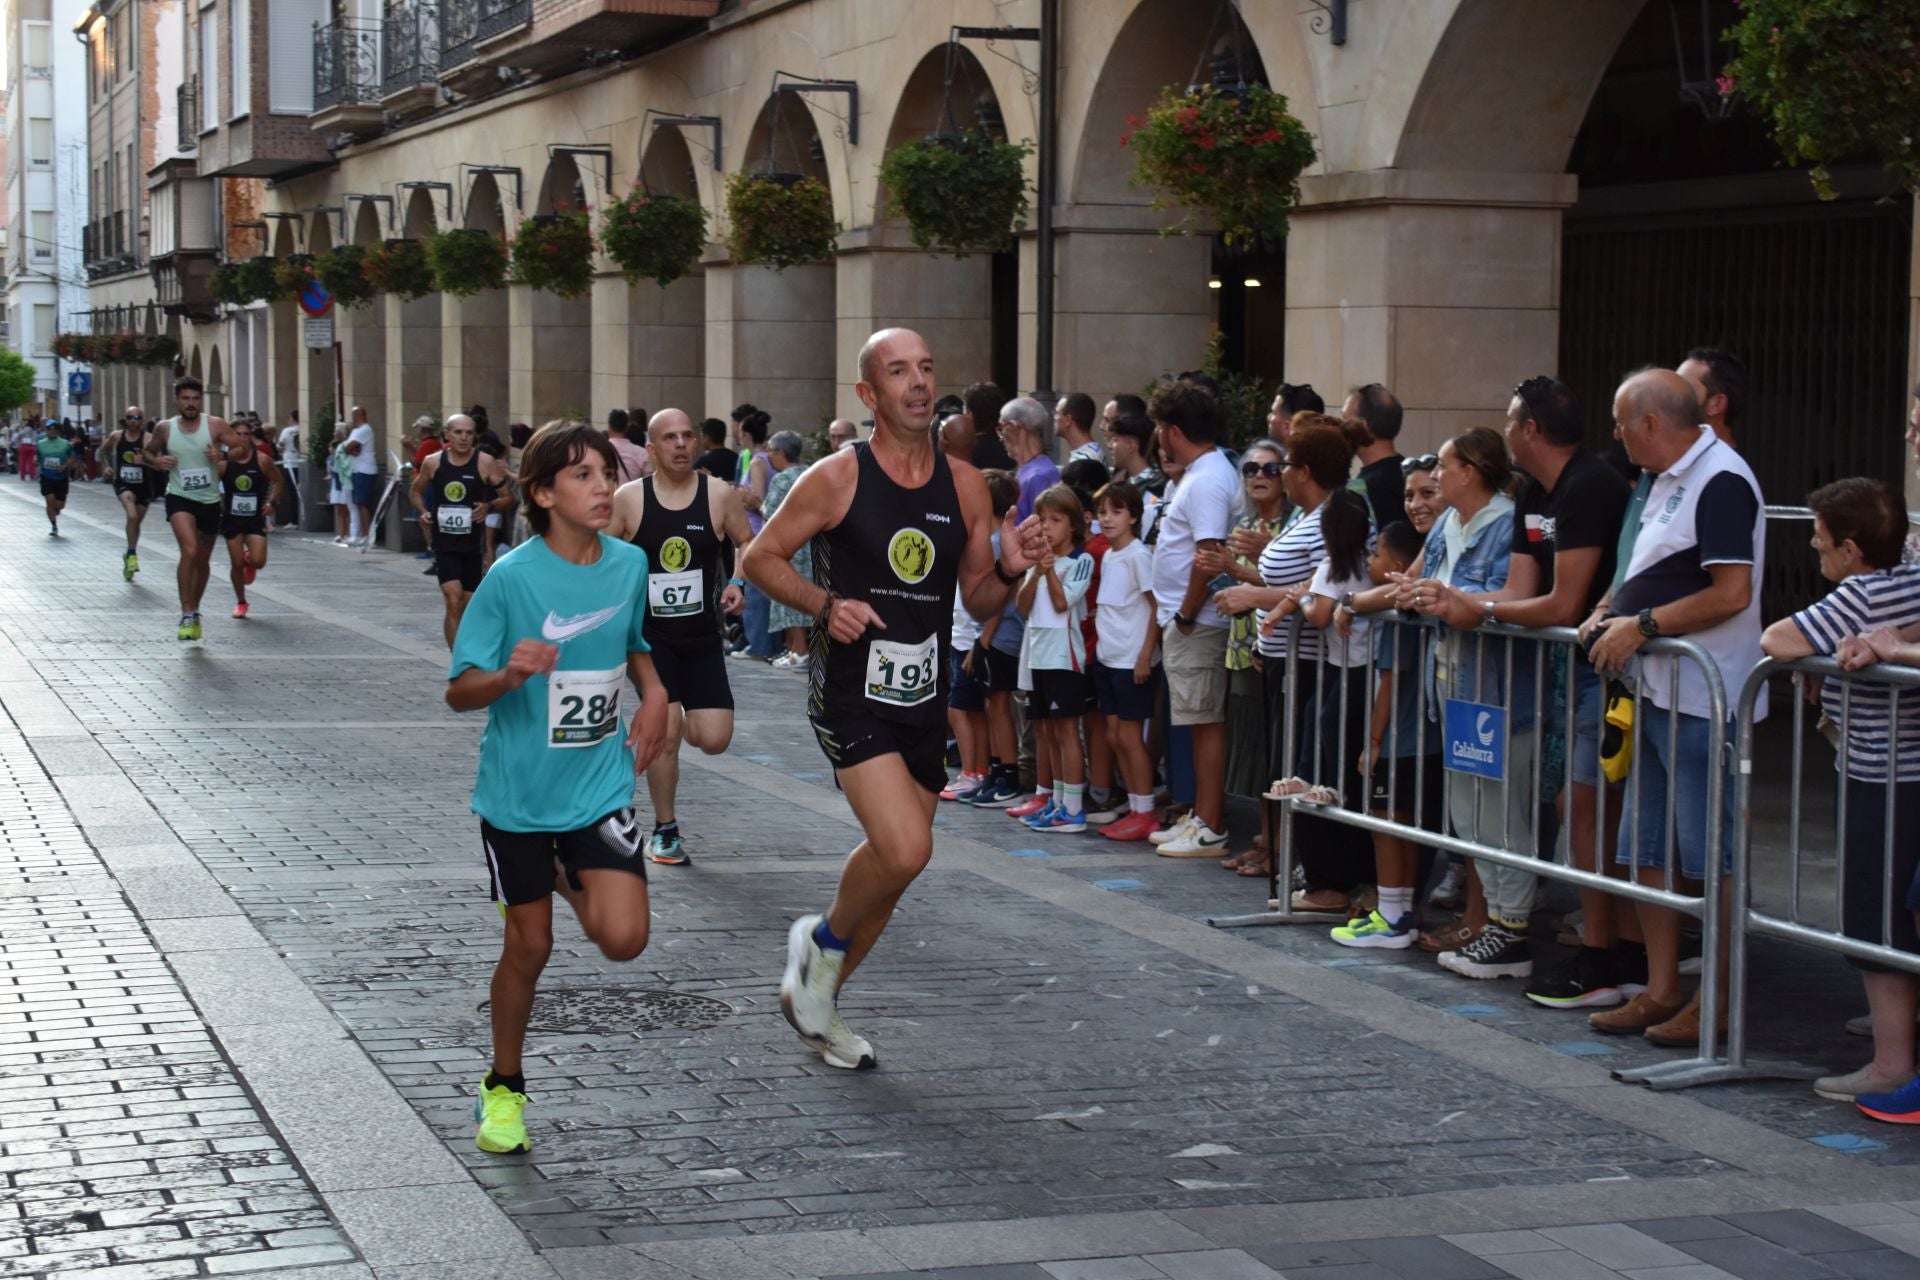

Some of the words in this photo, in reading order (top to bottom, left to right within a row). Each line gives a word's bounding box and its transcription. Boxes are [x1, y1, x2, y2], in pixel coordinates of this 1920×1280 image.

[184, 475, 209, 487] 251
[238, 502, 252, 512] 66
[446, 515, 464, 527] 40
[663, 586, 692, 605] 67
[878, 658, 933, 689] 193
[559, 688, 620, 725] 284
[1452, 740, 1494, 764] Calahorra
